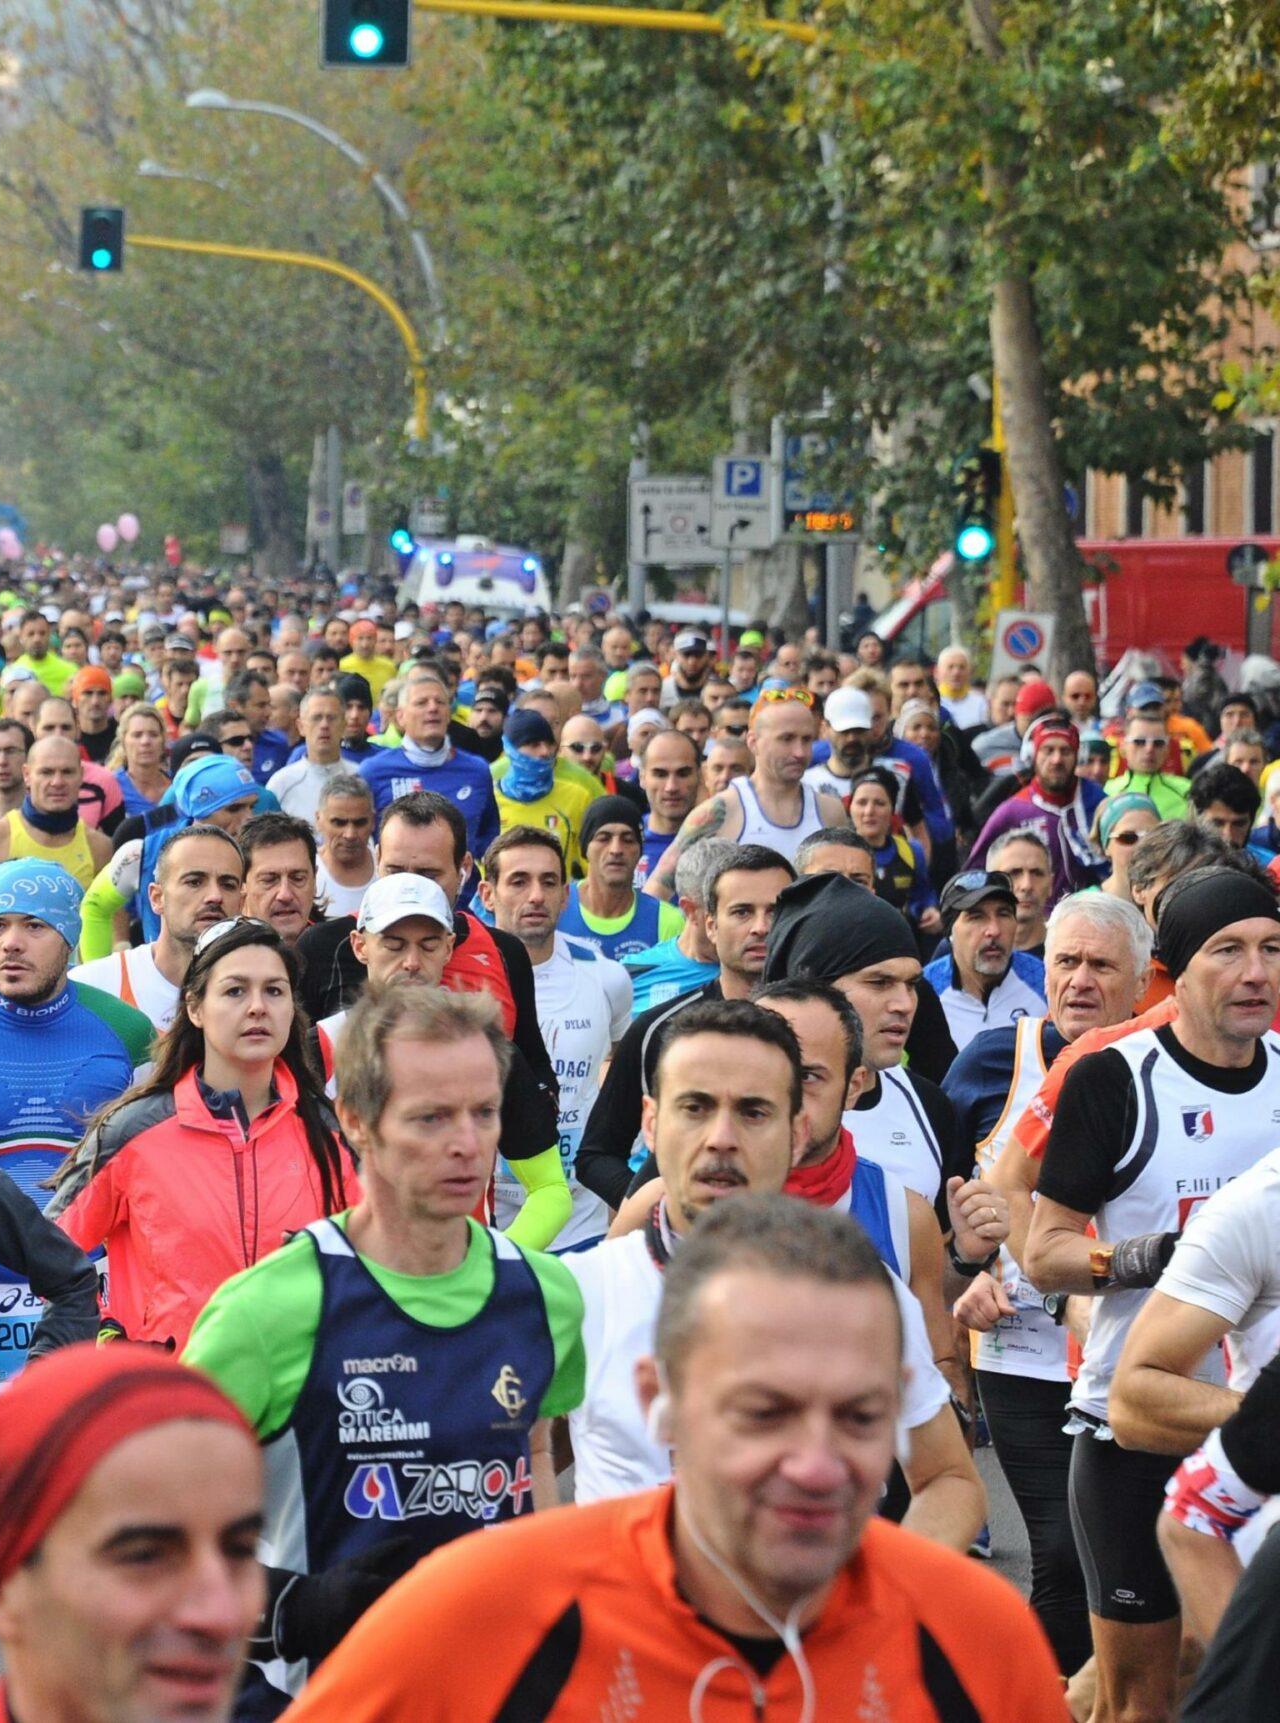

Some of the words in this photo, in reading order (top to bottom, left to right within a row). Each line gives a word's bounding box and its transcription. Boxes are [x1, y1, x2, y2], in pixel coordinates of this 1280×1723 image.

[732, 464, 756, 495] P
[16, 993, 70, 1018] BIONIC
[564, 1018, 592, 1030] DYLAN
[343, 1353, 418, 1374] macron
[338, 1408, 406, 1428] OTTICA
[339, 1421, 431, 1444] MAREMMI
